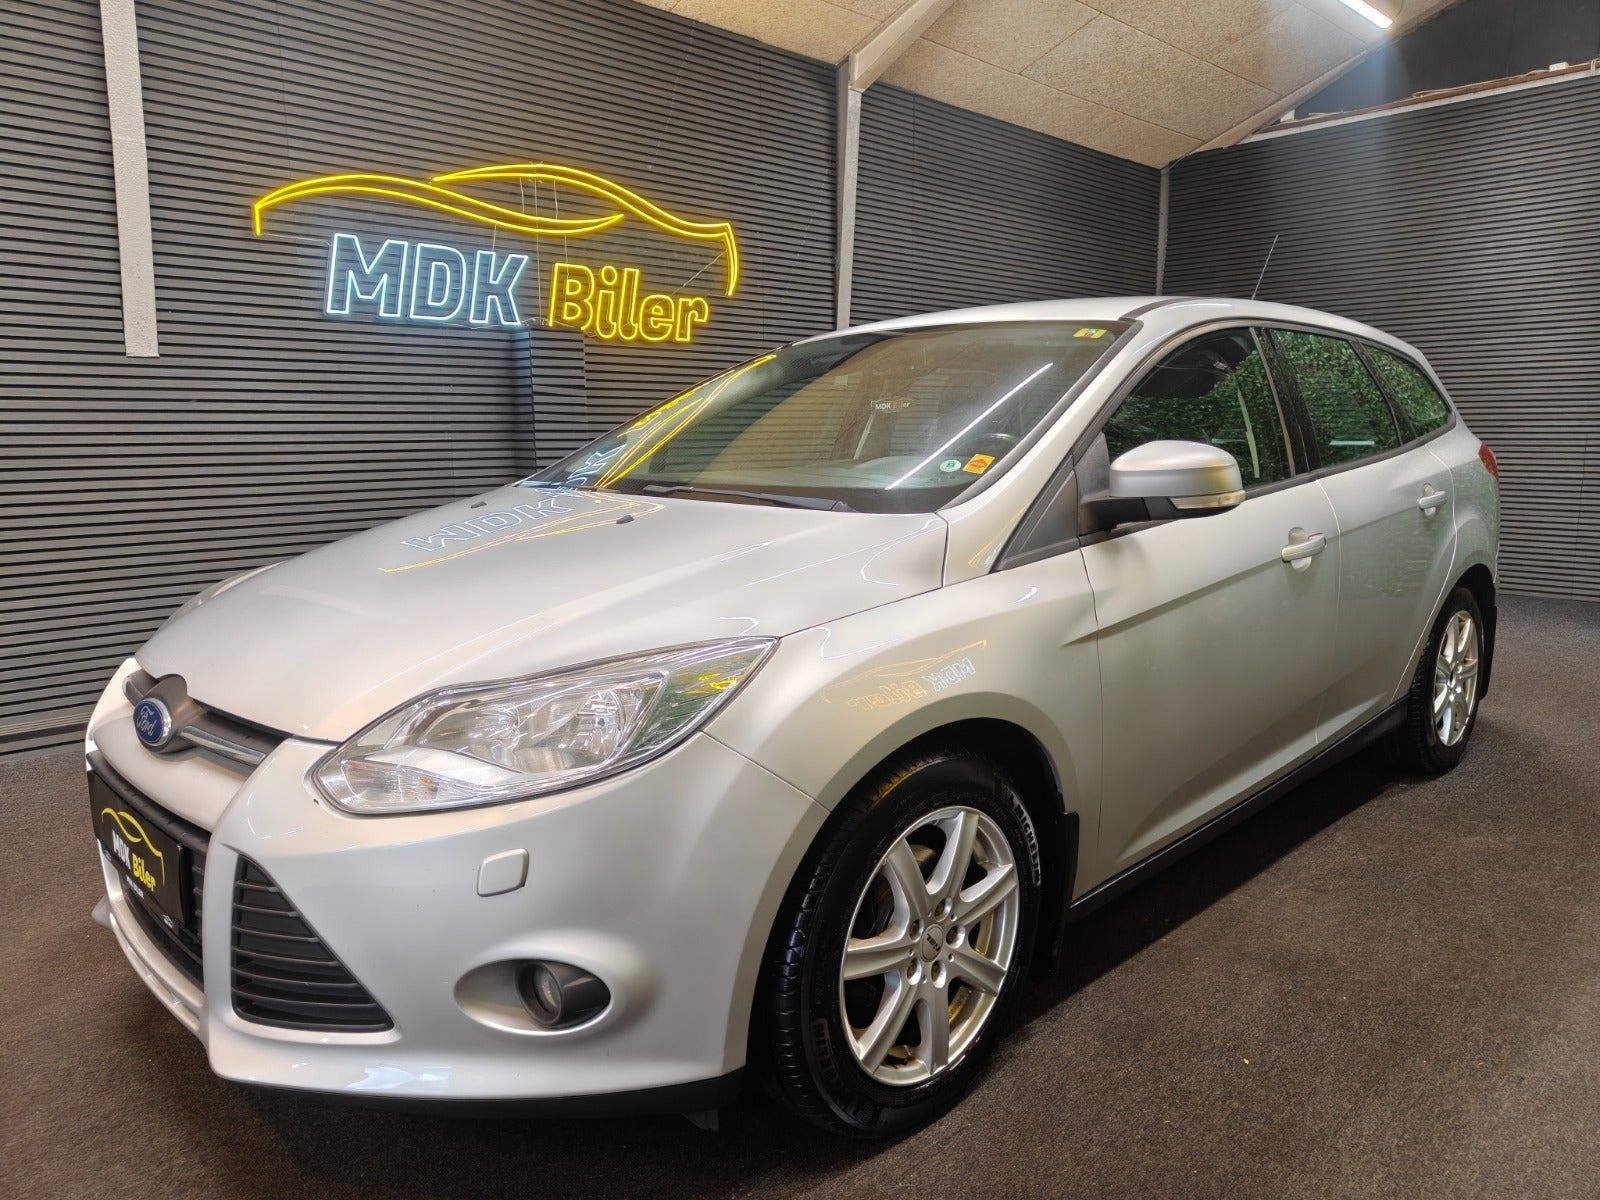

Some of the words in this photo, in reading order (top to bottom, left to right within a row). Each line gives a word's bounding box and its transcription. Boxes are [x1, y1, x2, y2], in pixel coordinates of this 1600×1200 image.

[327, 232, 529, 326] MDK
[548, 262, 709, 342] Biler
[874, 402, 891, 410] MDK
[136, 704, 158, 737] Ford
[112, 829, 131, 870] MDK
[132, 852, 156, 892] Biler
